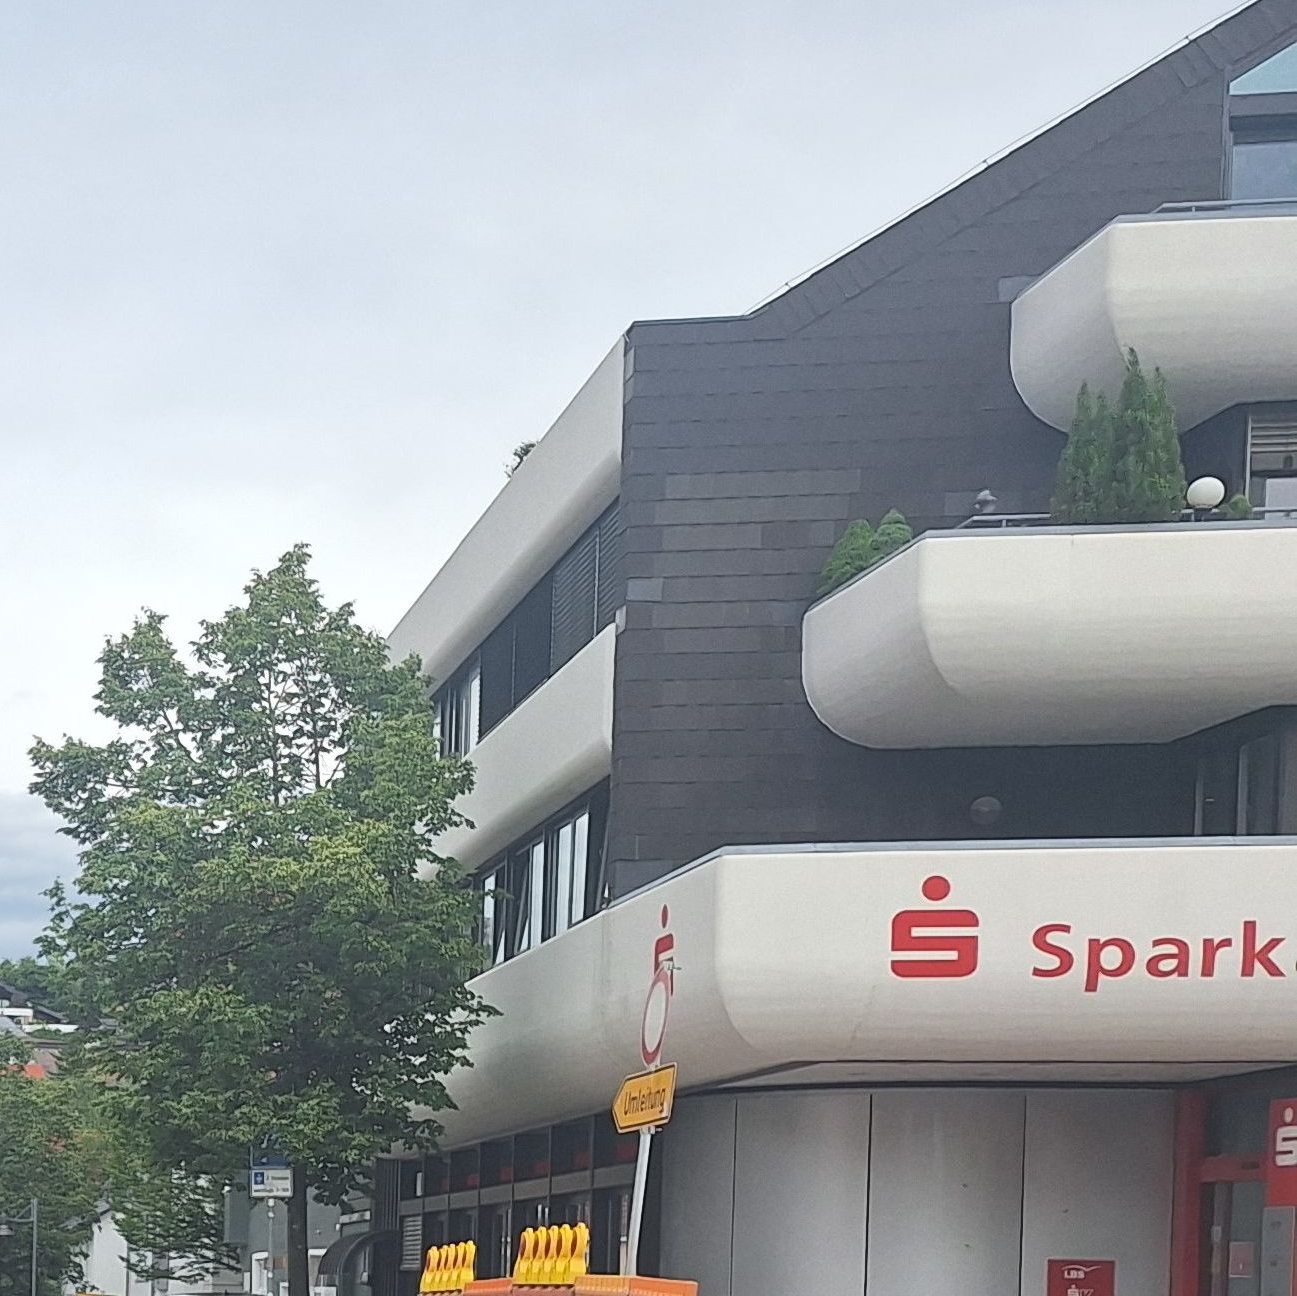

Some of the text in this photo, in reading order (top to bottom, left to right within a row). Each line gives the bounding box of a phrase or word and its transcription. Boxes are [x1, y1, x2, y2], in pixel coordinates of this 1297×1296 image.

[1032, 920, 1297, 992] Spark
[623, 1087, 666, 1116] Umleitung
[1064, 1270, 1085, 1279] LBS
